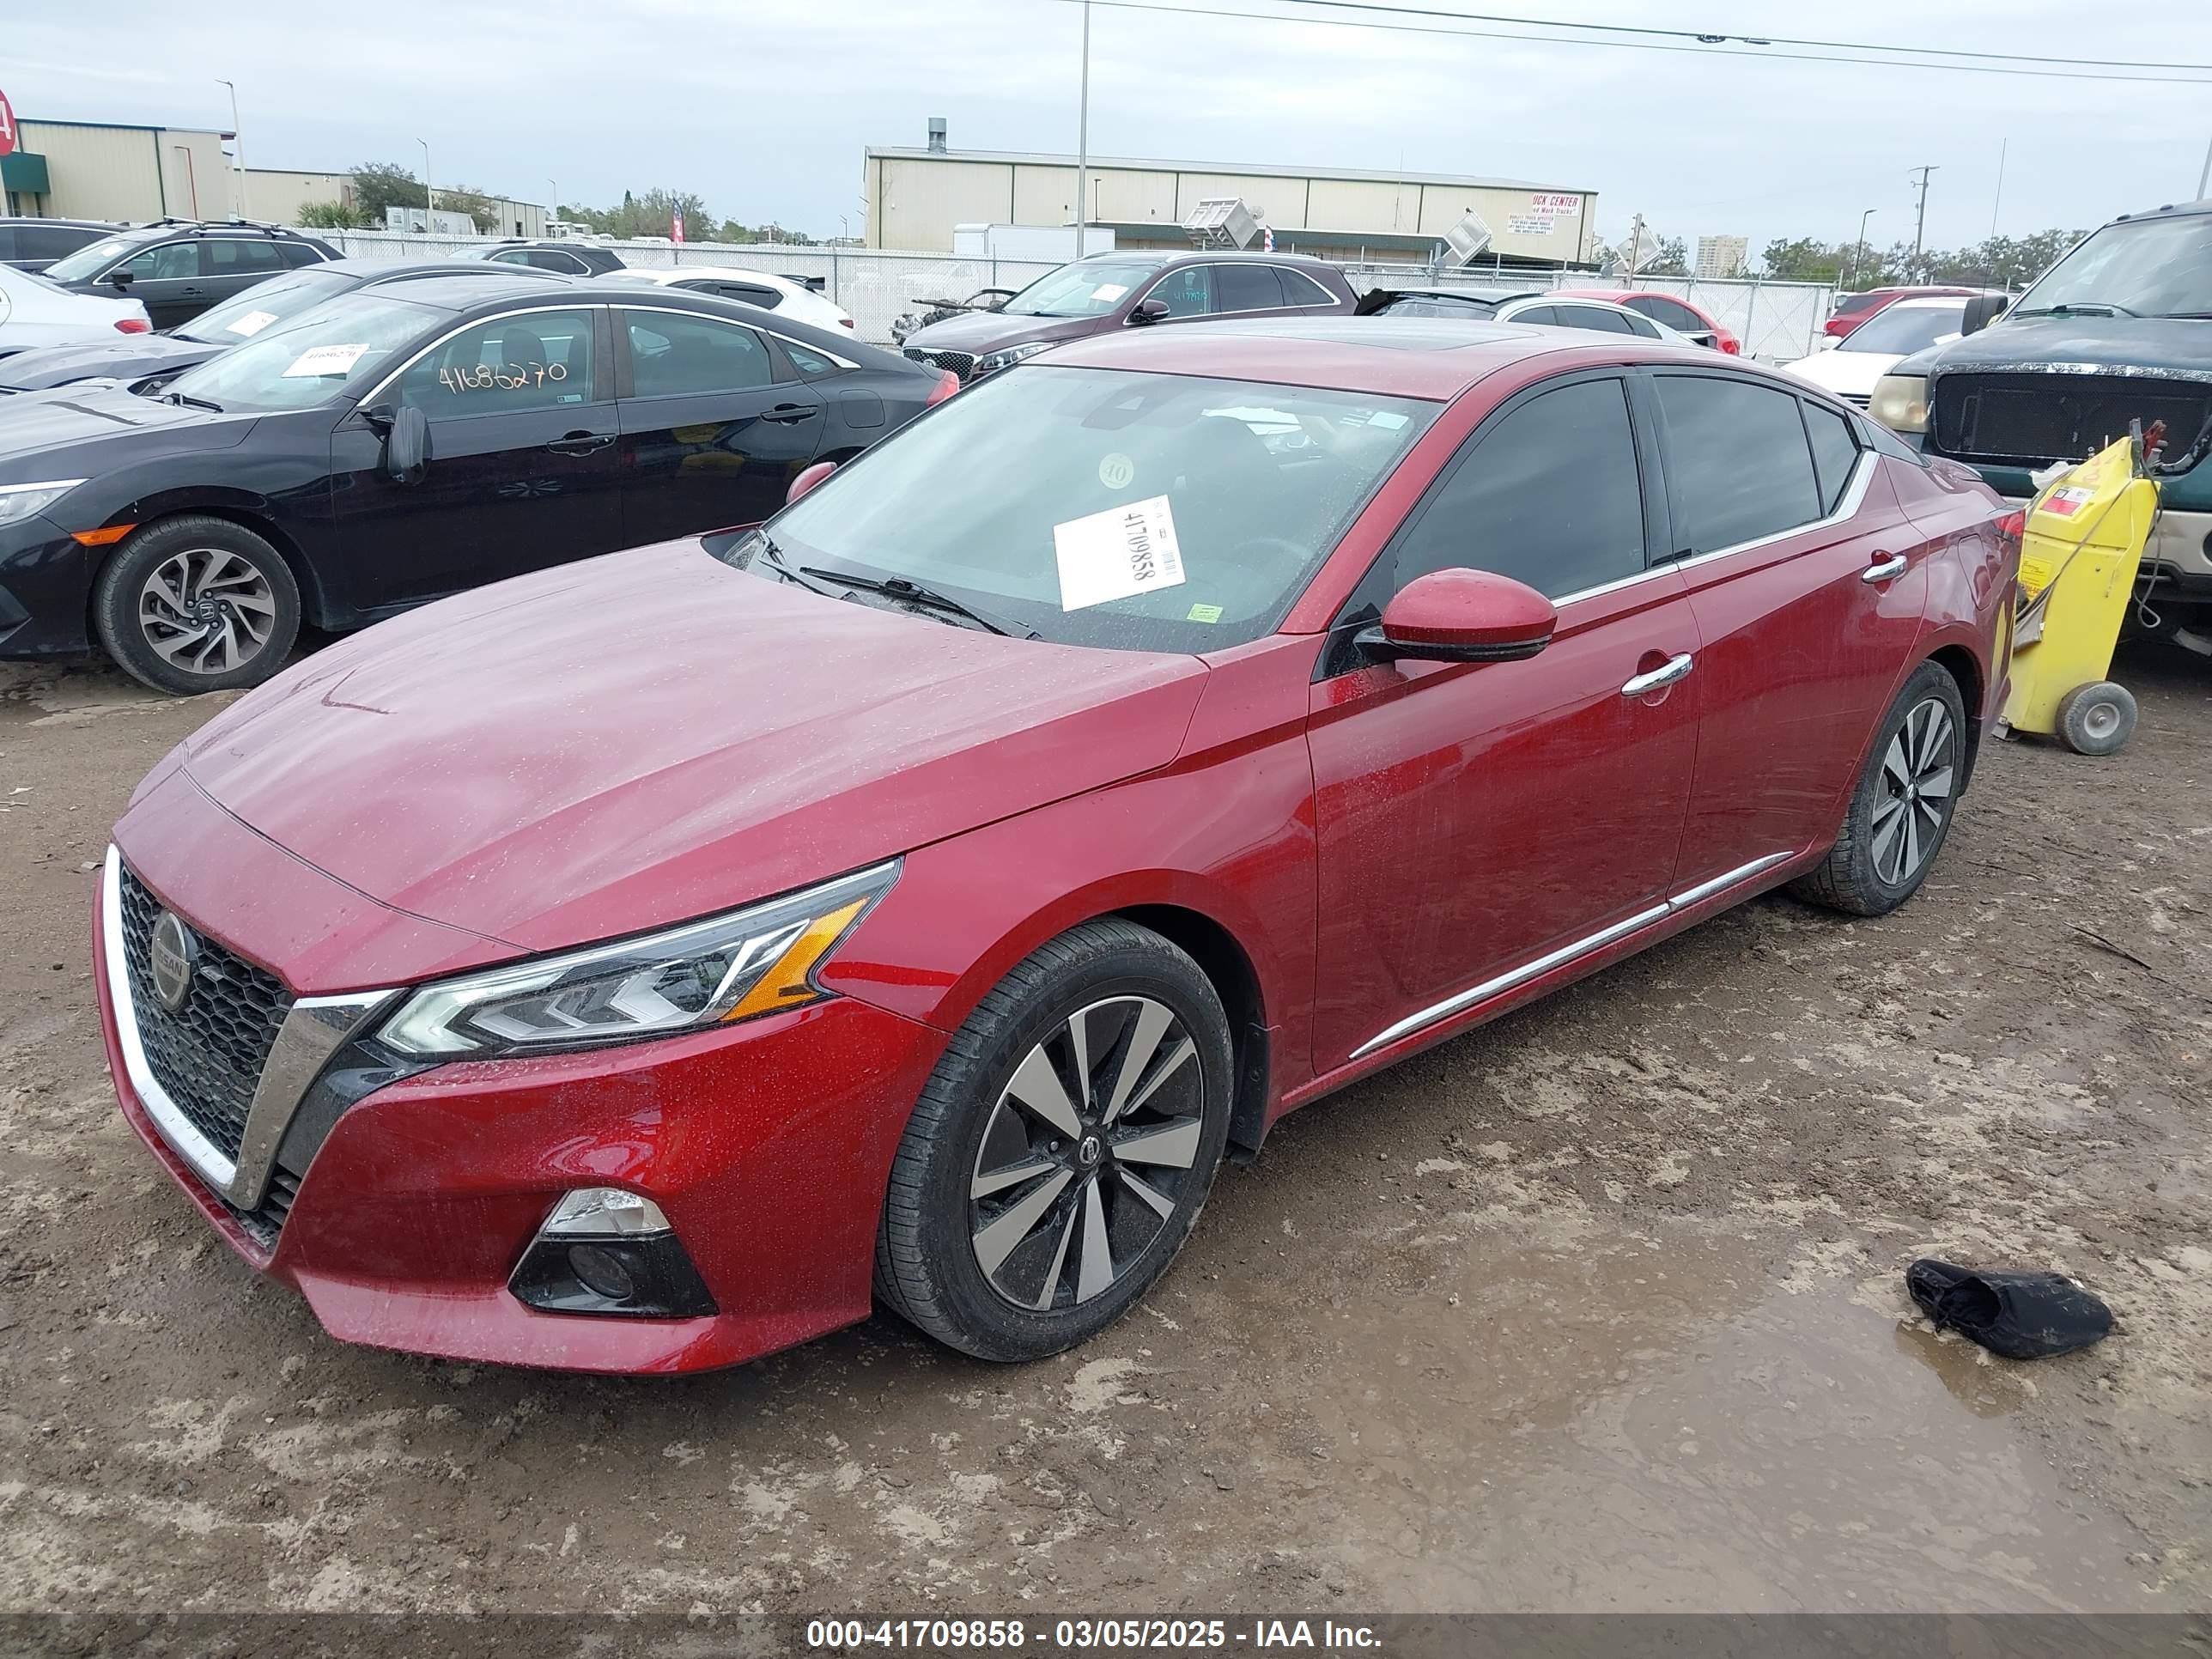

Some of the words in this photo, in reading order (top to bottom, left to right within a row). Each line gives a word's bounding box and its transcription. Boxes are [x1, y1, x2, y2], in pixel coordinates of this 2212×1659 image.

[1550, 196, 1578, 207] CENTER
[439, 362, 567, 395] 41686270
[1123, 513, 1156, 581] 41709858
